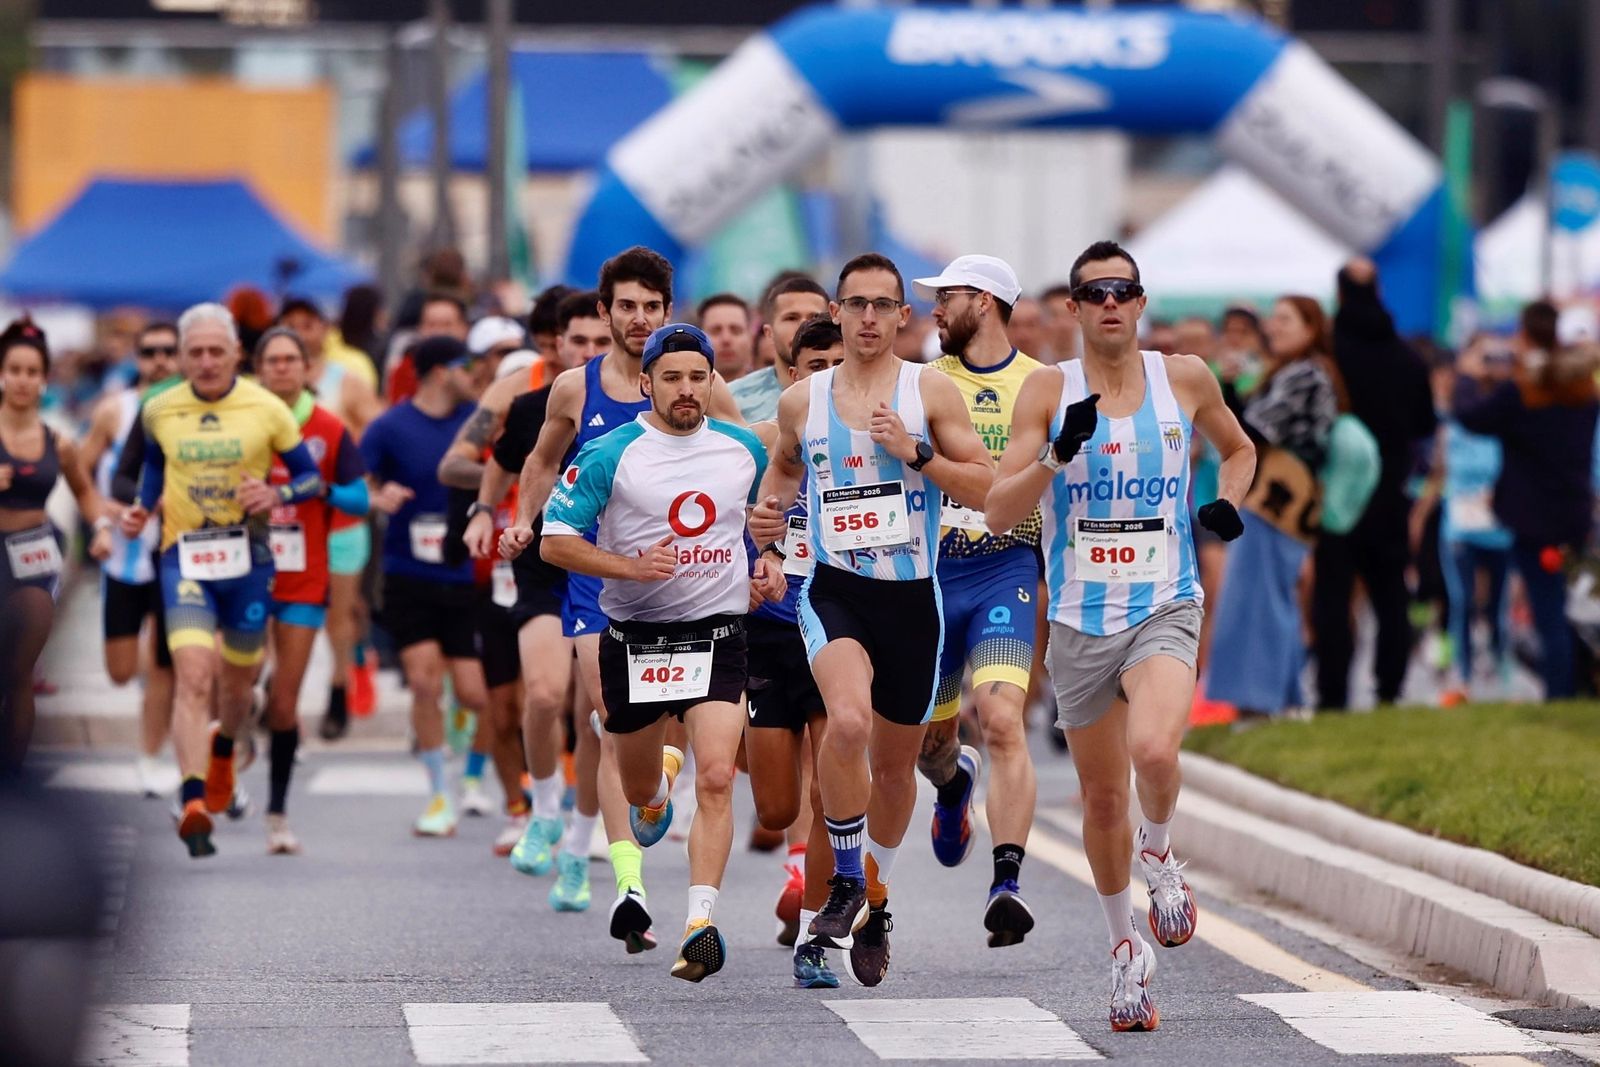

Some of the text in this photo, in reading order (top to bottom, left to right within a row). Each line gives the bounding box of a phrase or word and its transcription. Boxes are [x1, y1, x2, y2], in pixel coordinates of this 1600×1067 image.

[885, 9, 1168, 68] BROOKS
[808, 437, 828, 448] vive
[839, 489, 860, 497] Marcha
[863, 487, 881, 496] 2026
[833, 511, 879, 533] 556
[1124, 522, 1143, 530] 2026
[794, 543, 809, 559] 3
[1090, 546, 1136, 564] 810
[640, 666, 685, 684] 402
